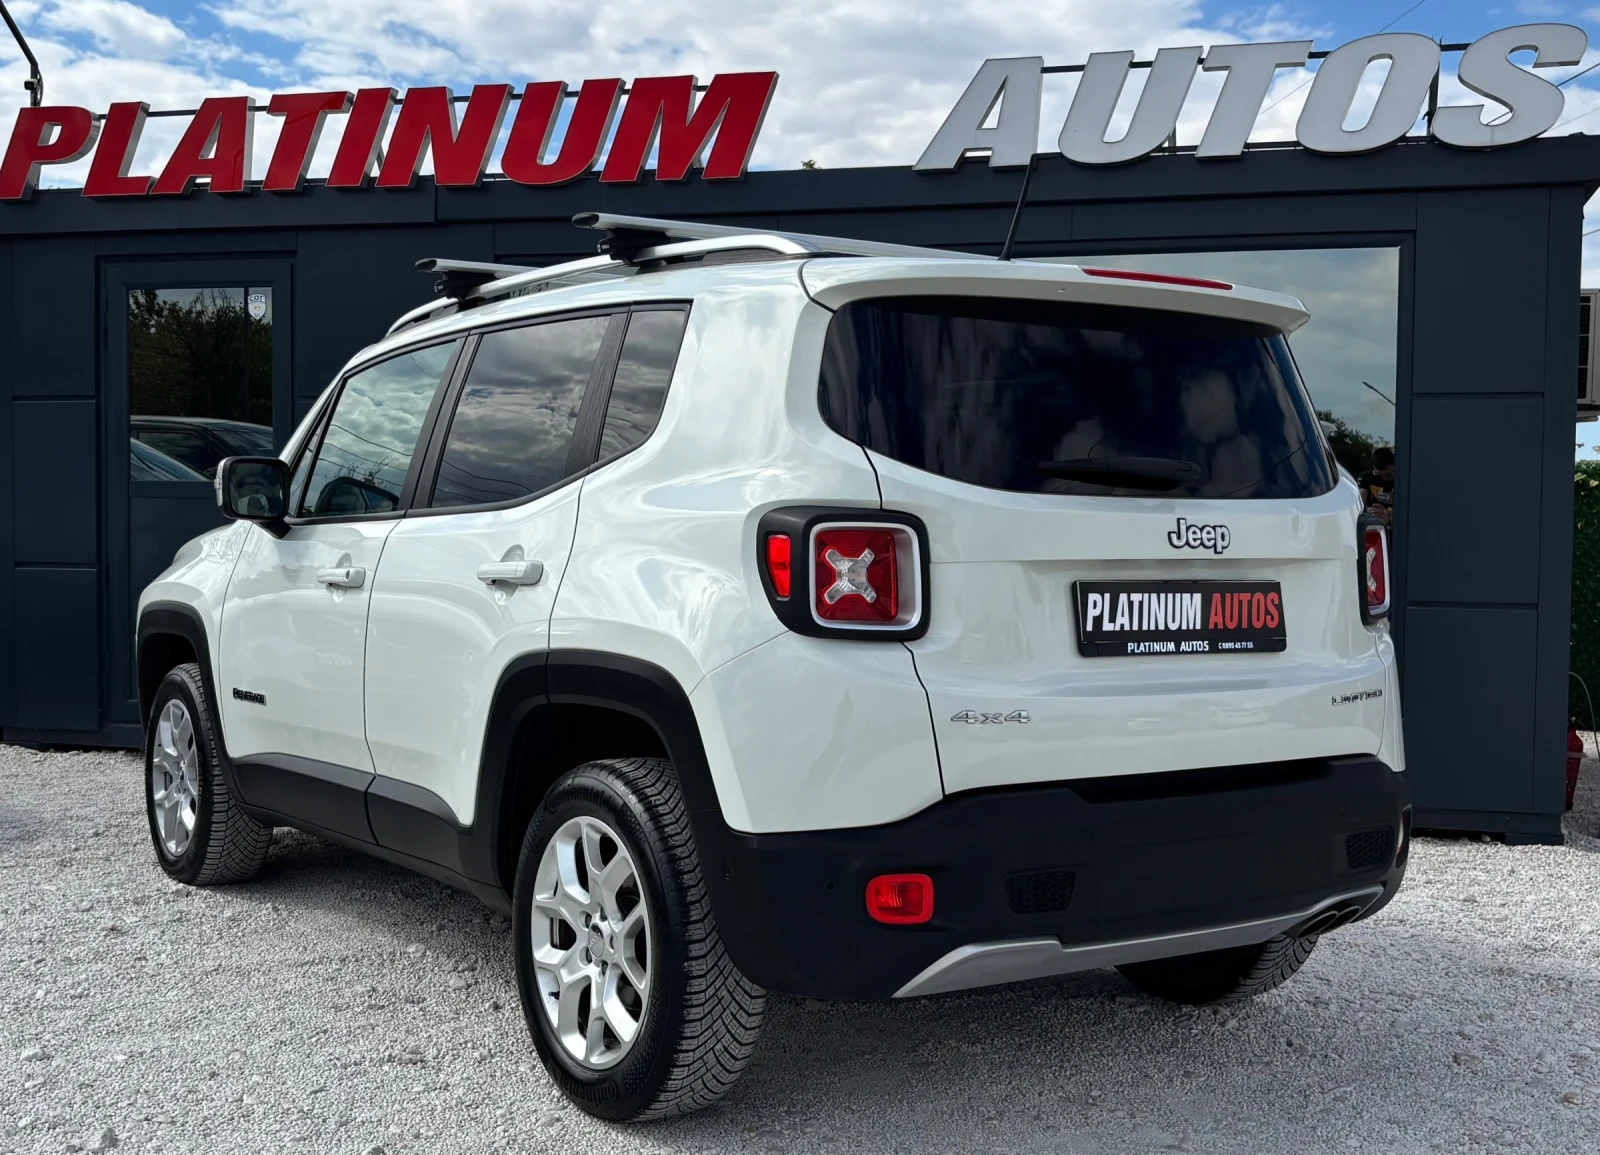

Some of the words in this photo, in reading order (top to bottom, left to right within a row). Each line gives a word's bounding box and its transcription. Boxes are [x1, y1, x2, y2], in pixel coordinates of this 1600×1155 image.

[0, 71, 779, 201] PLATINUM
[912, 23, 1588, 172] AUTOS
[1168, 517, 1231, 554] Jeep
[1086, 592, 1202, 632] PLATINUM
[1208, 592, 1280, 630] AUTOS
[1127, 641, 1176, 654] PLATINUM
[1179, 640, 1209, 652] AUTOS
[950, 709, 1032, 725] 4x4
